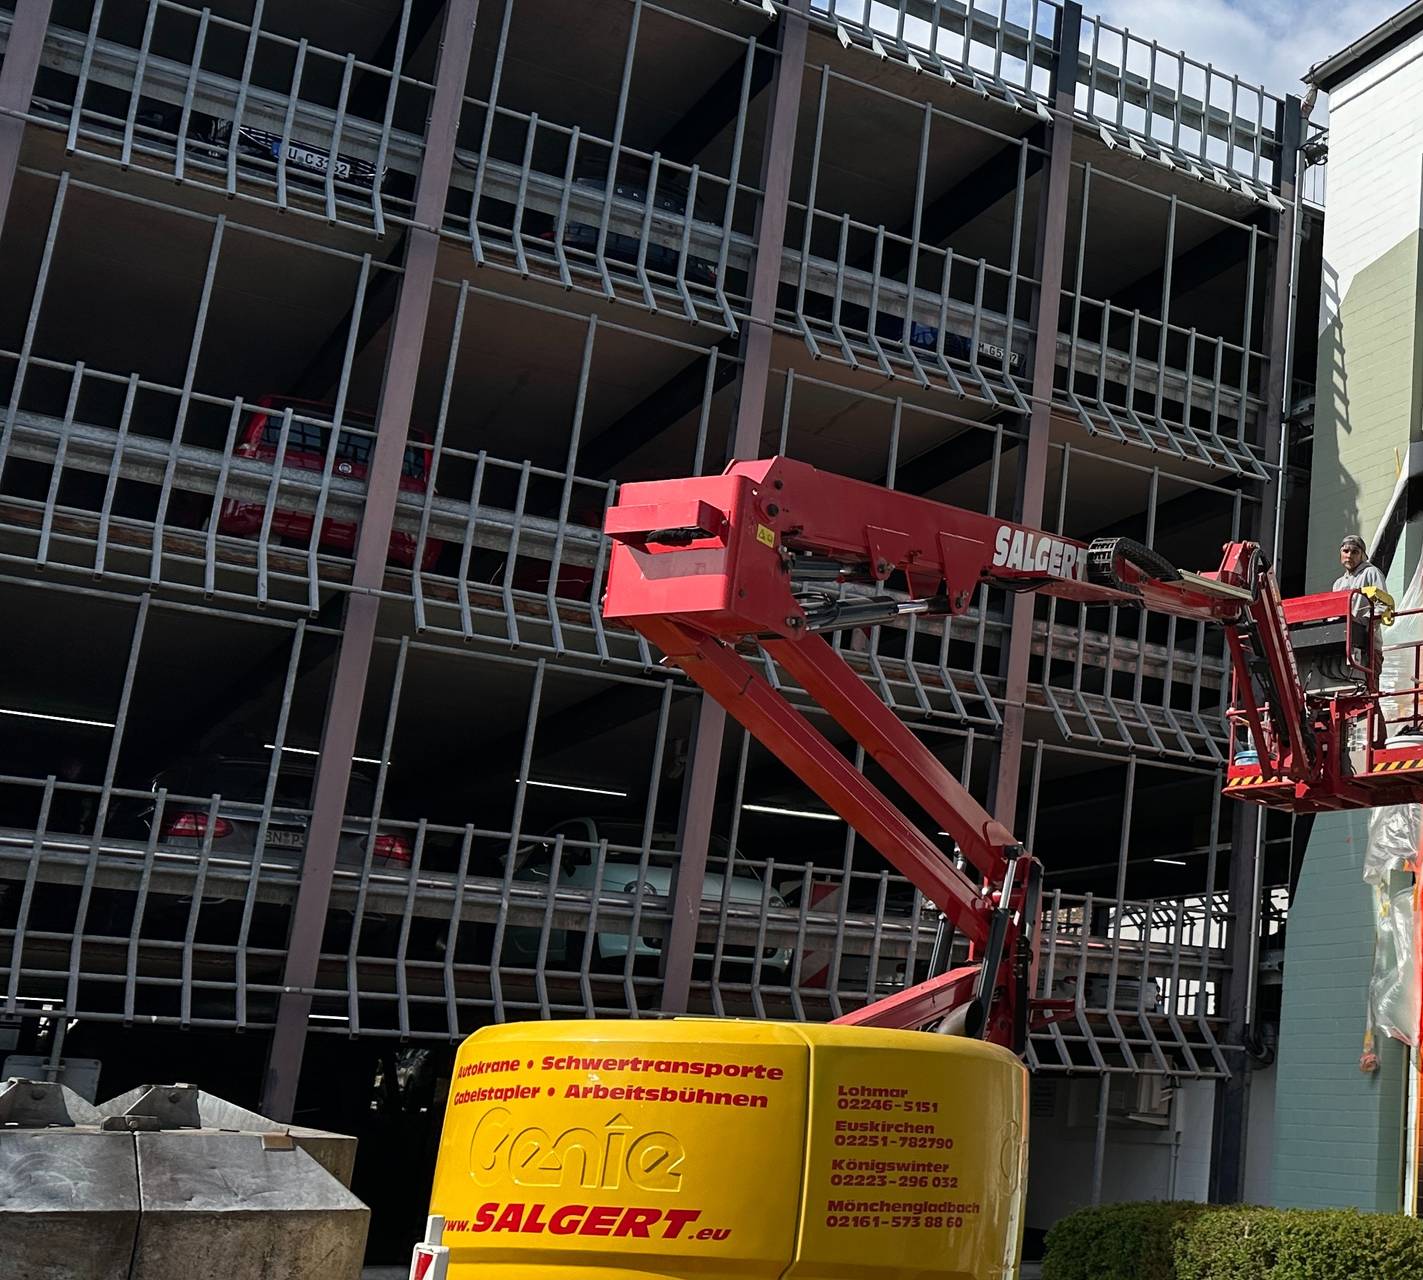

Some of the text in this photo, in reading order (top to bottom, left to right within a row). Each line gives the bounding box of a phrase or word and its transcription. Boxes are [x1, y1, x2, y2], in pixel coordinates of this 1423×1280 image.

[992, 525, 1089, 582] SALGERT
[457, 1055, 784, 1080] Autokrane Schwertransporte
[454, 1084, 769, 1108] Gabelstapler Arbeitsbühnen
[838, 1085, 909, 1098] Lohmar
[837, 1098, 939, 1113] 02246-5151
[835, 1120, 935, 1134] Euskirchen
[469, 1106, 686, 1193] Genie
[834, 1134, 954, 1150] 02251-782790
[831, 1158, 950, 1174] Königswinter
[830, 1174, 958, 1188] 02223-296 032
[827, 1199, 980, 1215] Mönchengladbach
[443, 1202, 733, 1241] ww.SALGERT.eu
[826, 1215, 964, 1229] 02161-573 88 60
